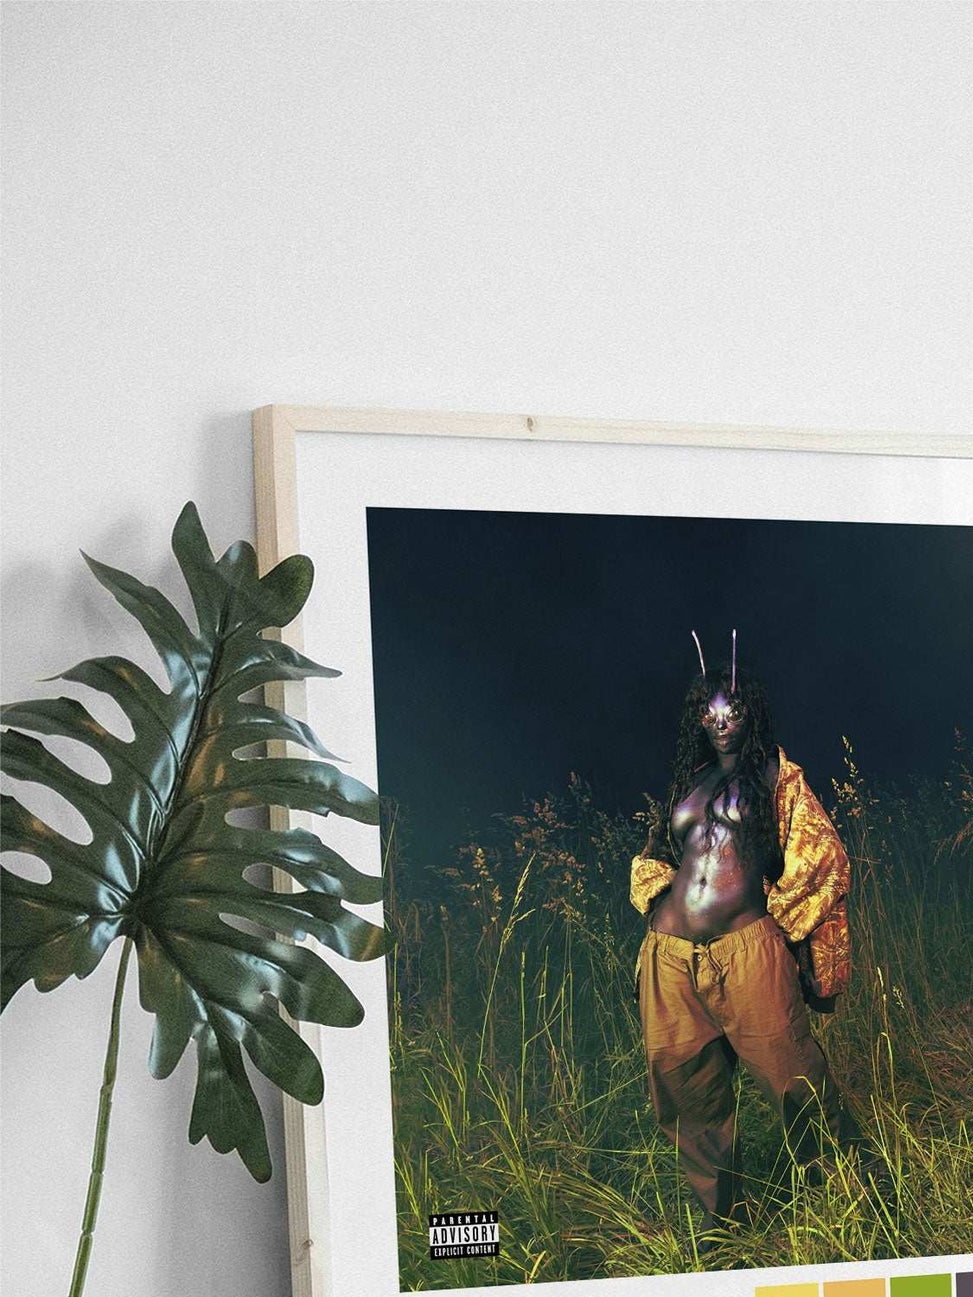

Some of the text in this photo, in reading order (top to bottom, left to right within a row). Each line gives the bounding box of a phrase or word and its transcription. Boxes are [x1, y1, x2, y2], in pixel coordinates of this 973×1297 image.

[432, 1214, 495, 1226] PARENTAL
[432, 1225, 496, 1245] ADVISORY
[434, 1244, 496, 1257] EXPLICIT CONTENT
